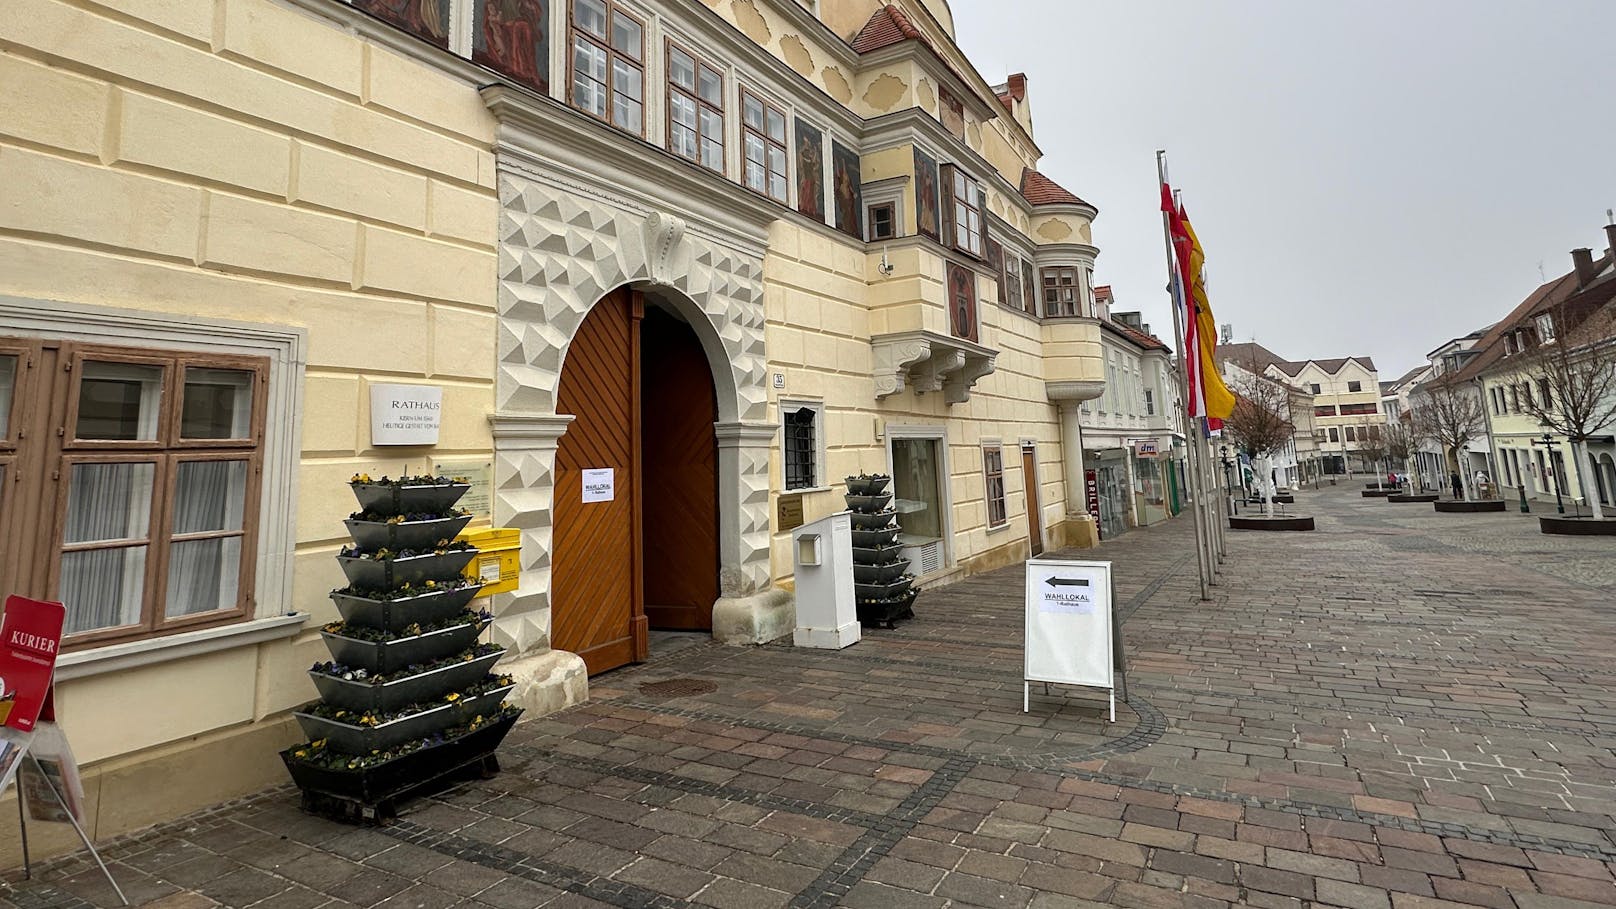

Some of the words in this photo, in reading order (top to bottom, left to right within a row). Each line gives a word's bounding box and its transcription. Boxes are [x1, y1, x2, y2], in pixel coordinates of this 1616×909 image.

[392, 400, 440, 410] RATHAUS
[1140, 443, 1155, 452] dm
[1044, 592, 1089, 602] WAHLLOKAL
[11, 630, 55, 653] KURIER
